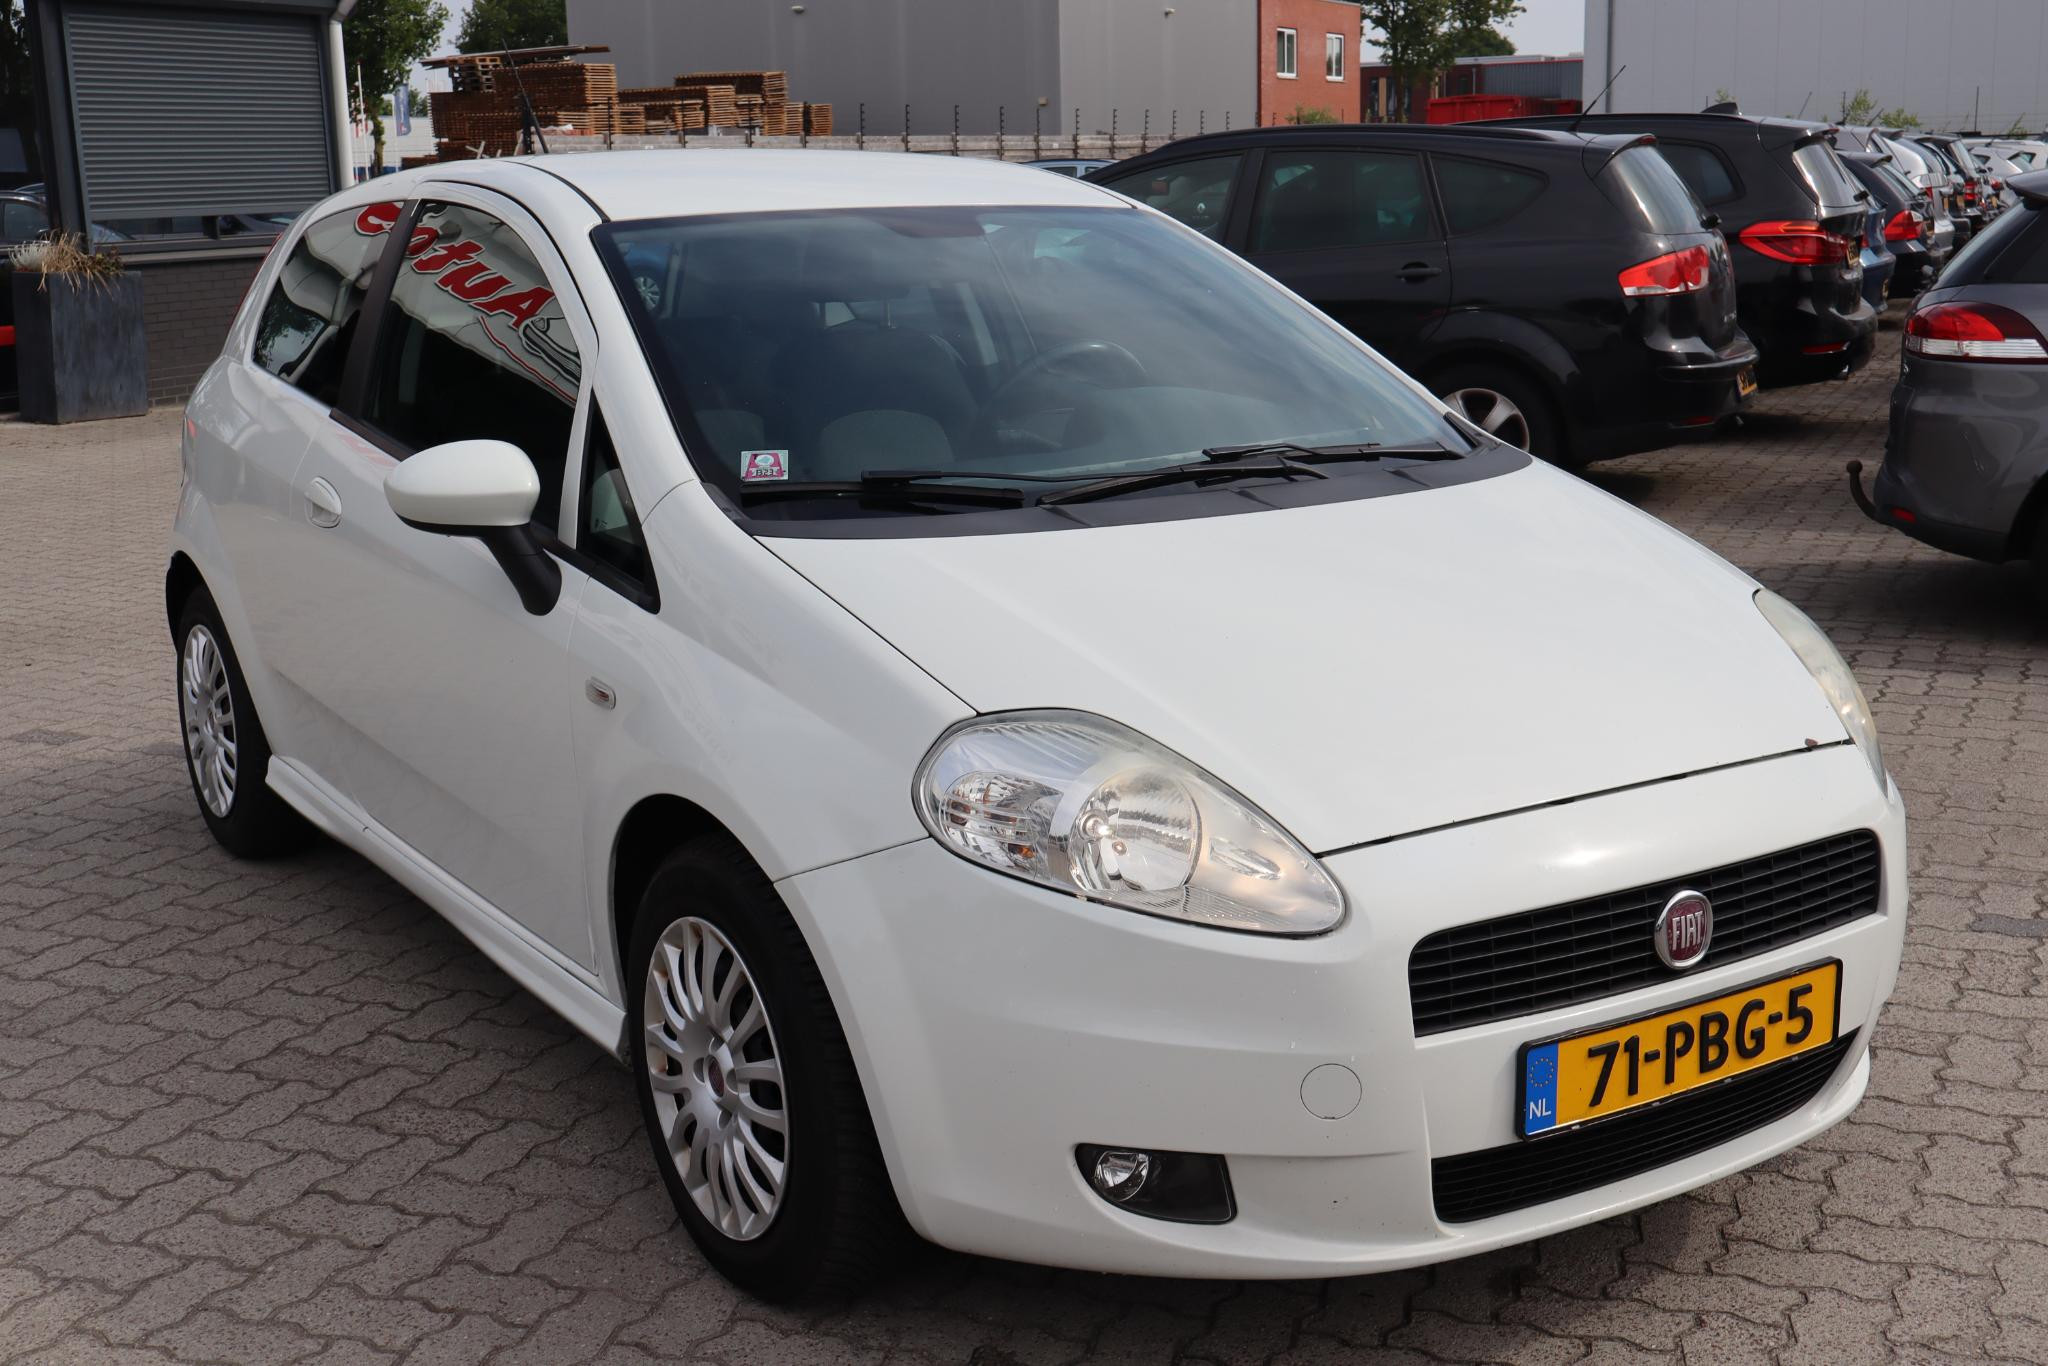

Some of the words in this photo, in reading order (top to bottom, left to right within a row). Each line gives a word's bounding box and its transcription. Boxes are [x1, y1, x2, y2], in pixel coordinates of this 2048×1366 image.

[1671, 910, 1704, 951] FIAT
[1587, 983, 1814, 1107] 71-PBG-5
[1529, 1098, 1552, 1120] NL
